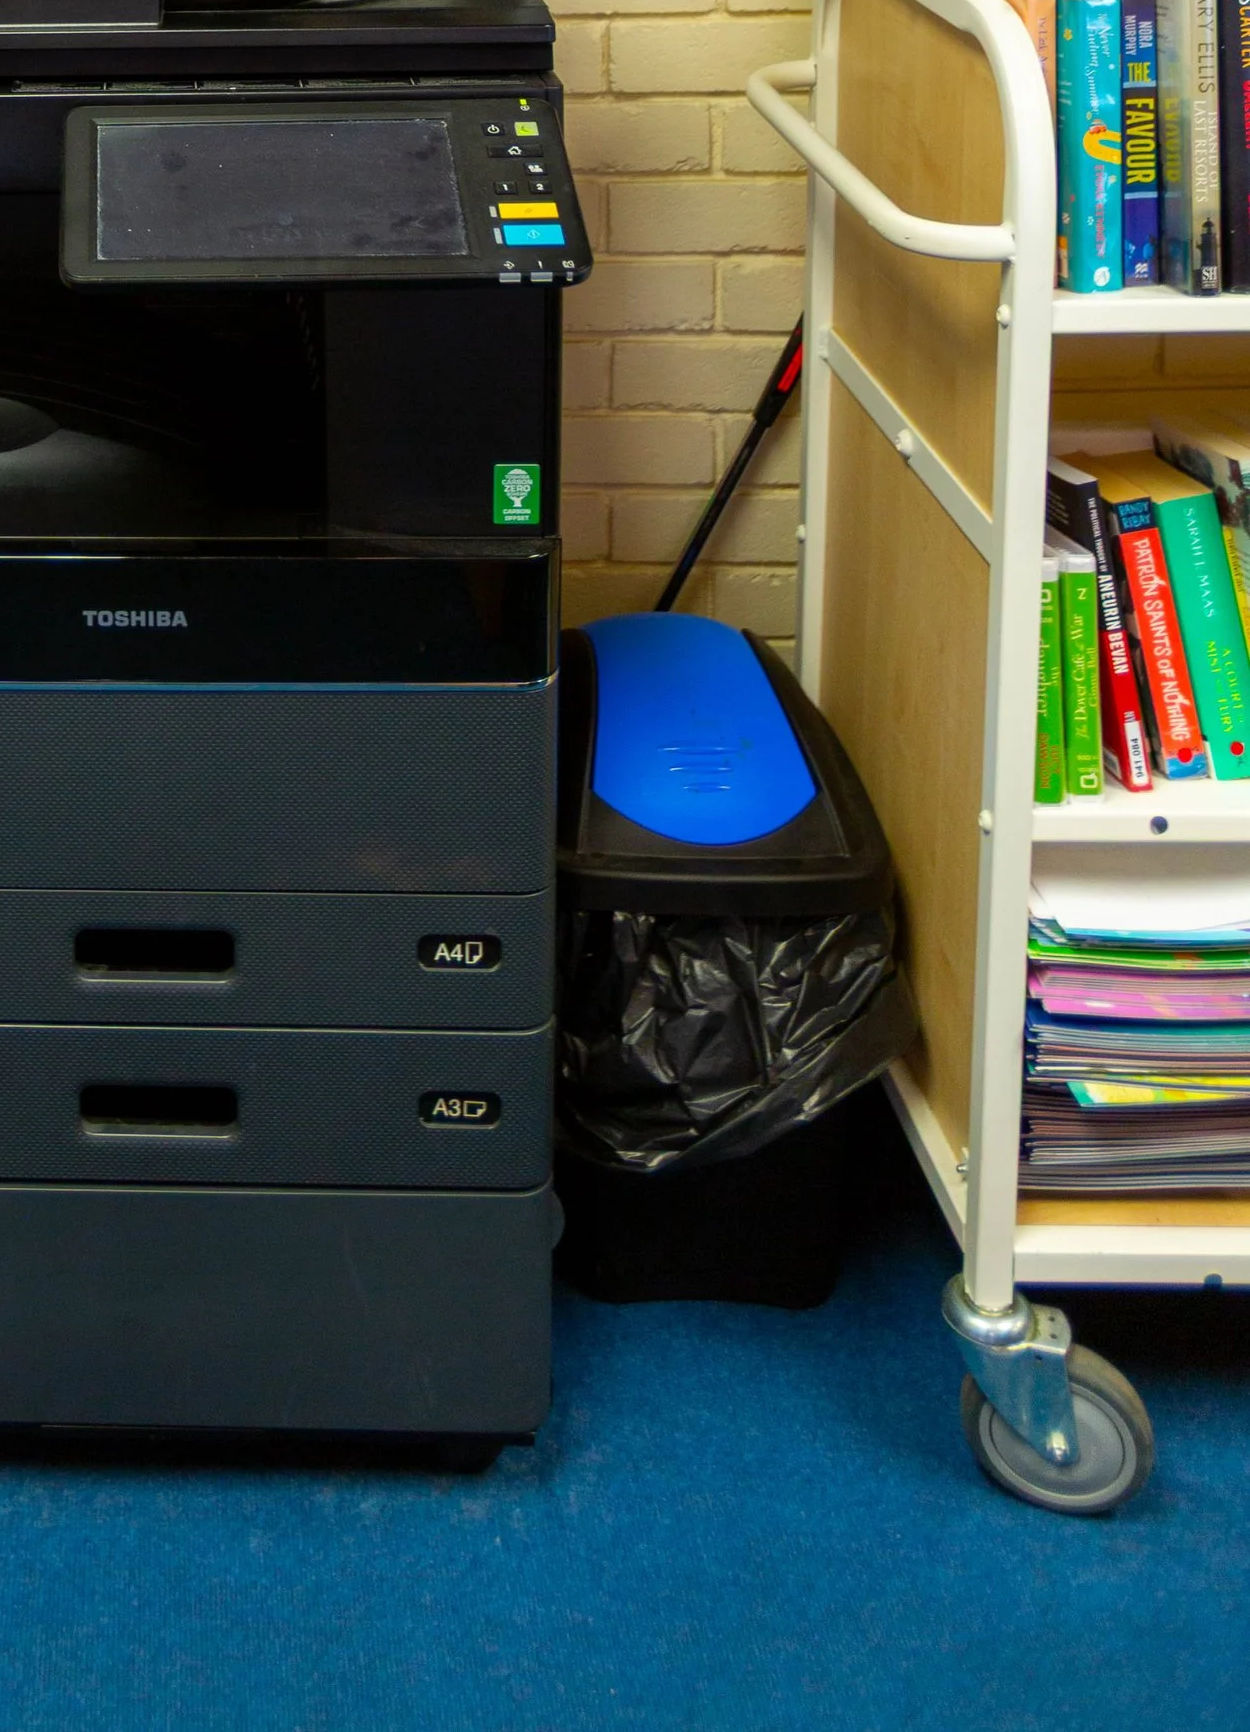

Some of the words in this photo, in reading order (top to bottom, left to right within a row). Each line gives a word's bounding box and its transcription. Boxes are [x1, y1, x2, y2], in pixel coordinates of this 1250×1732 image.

[1096, 25, 1112, 57] Never
[1124, 15, 1137, 55] MURPHY
[1138, 21, 1152, 48] NORA
[1128, 62, 1151, 82] THE
[1197, 42, 1215, 93] ELLIS
[1085, 66, 1100, 114] Summer
[1195, 100, 1207, 135] LAST
[1125, 97, 1156, 185] FAVOUR
[1195, 139, 1208, 203] RESORTS
[504, 484, 531, 493] ZERO
[1089, 510, 1101, 537] POLITICAL
[1117, 500, 1149, 516] RANDY
[1122, 512, 1150, 529] RIBAY
[1133, 538, 1160, 598] PATRON
[1183, 508, 1203, 559] SARAH
[1199, 574, 1215, 619] MAAS
[83, 610, 188, 628] TOSHIBA
[1098, 574, 1122, 630] ANEURIN
[1071, 614, 1085, 640] War
[1143, 598, 1173, 657] SAINTS
[1072, 653, 1086, 681] Café
[1107, 630, 1129, 675] BEVAN
[1157, 659, 1175, 684] OF
[1074, 684, 1087, 721] Dover
[1161, 681, 1191, 742] NOTHING
[1217, 697, 1234, 732] FURY
[434, 943, 463, 962] A4
[432, 1099, 461, 1117] A3
